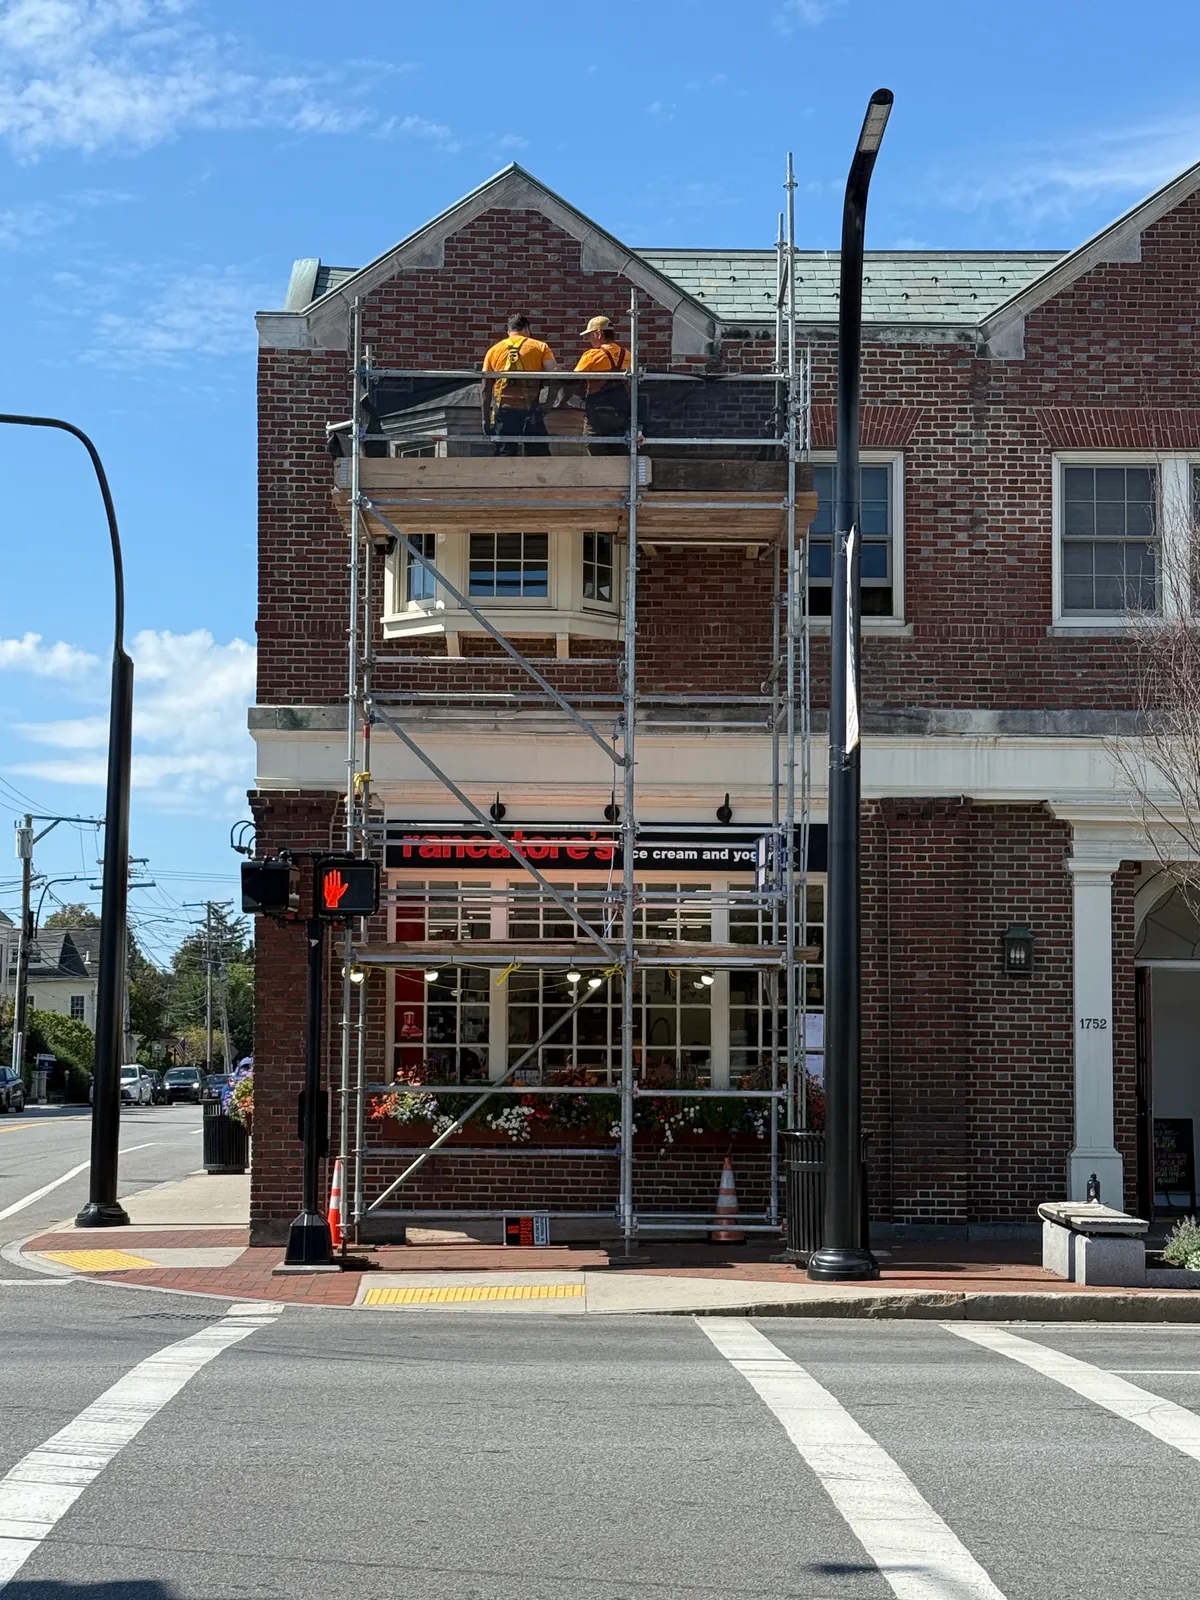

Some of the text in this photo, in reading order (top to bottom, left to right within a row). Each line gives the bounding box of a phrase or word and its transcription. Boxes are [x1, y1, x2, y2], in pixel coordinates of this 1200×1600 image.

[403, 830, 615, 860] rancatore's
[631, 849, 648, 859] ce
[652, 849, 698, 859] cream
[702, 849, 729, 860] and
[1079, 1018, 1107, 1029] 1752
